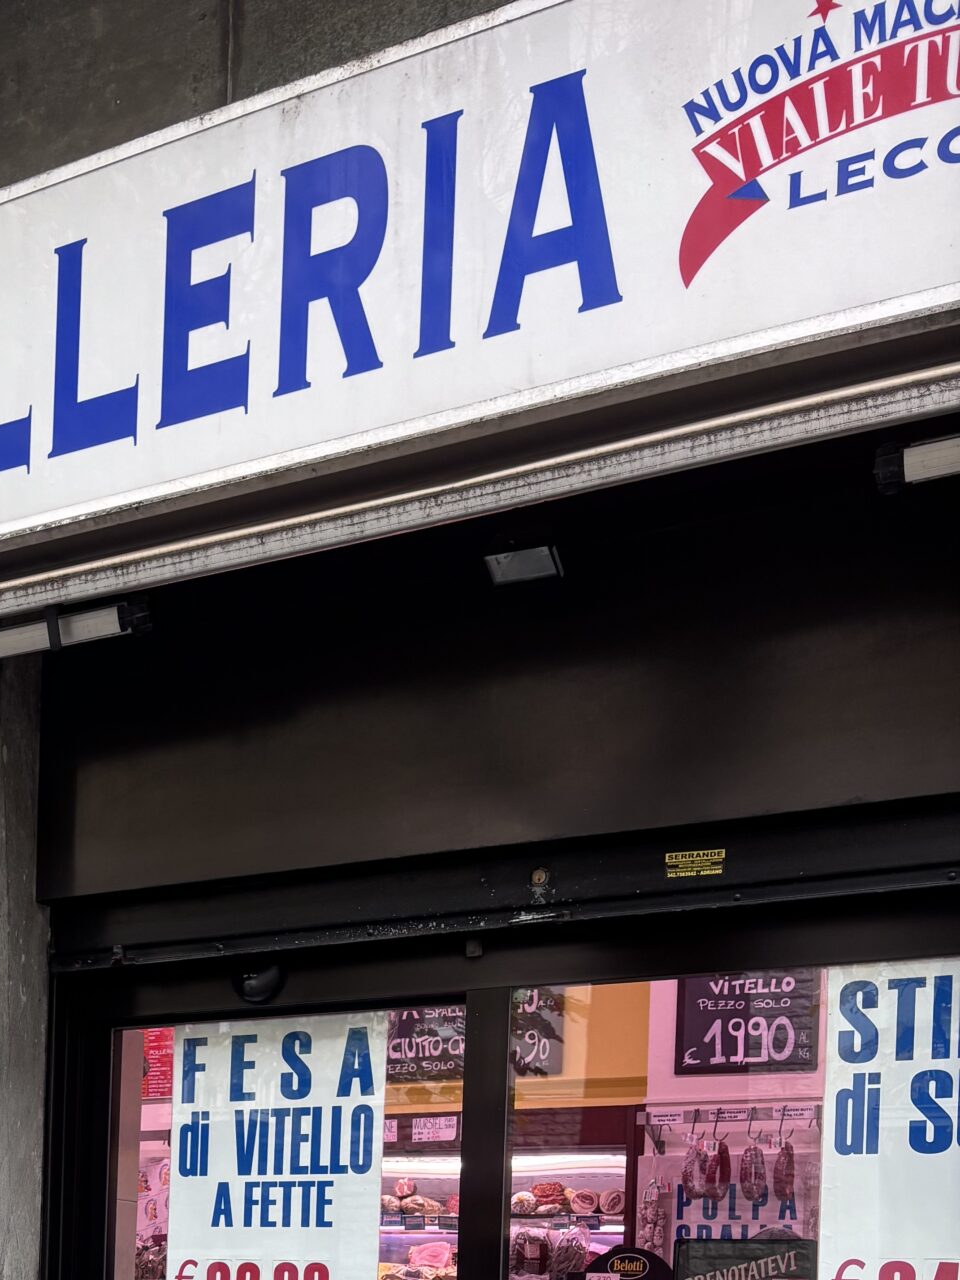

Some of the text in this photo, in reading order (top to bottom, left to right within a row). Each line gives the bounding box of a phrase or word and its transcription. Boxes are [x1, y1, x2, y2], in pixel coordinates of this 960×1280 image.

[682, 0, 960, 137] NUOVA MAC
[700, 54, 883, 182] VIALE
[668, 851, 723, 860] SERRANDE
[697, 998, 791, 1010] PEZZO SOLO
[838, 975, 960, 1064] STI
[181, 1026, 375, 1103] FESA
[387, 1061, 455, 1073] EZZO SOLO
[178, 1104, 374, 1177] di VITELLO
[834, 1069, 960, 1156] di S
[211, 1180, 334, 1227] A FETTE
[614, 1259, 644, 1272] Belotti
